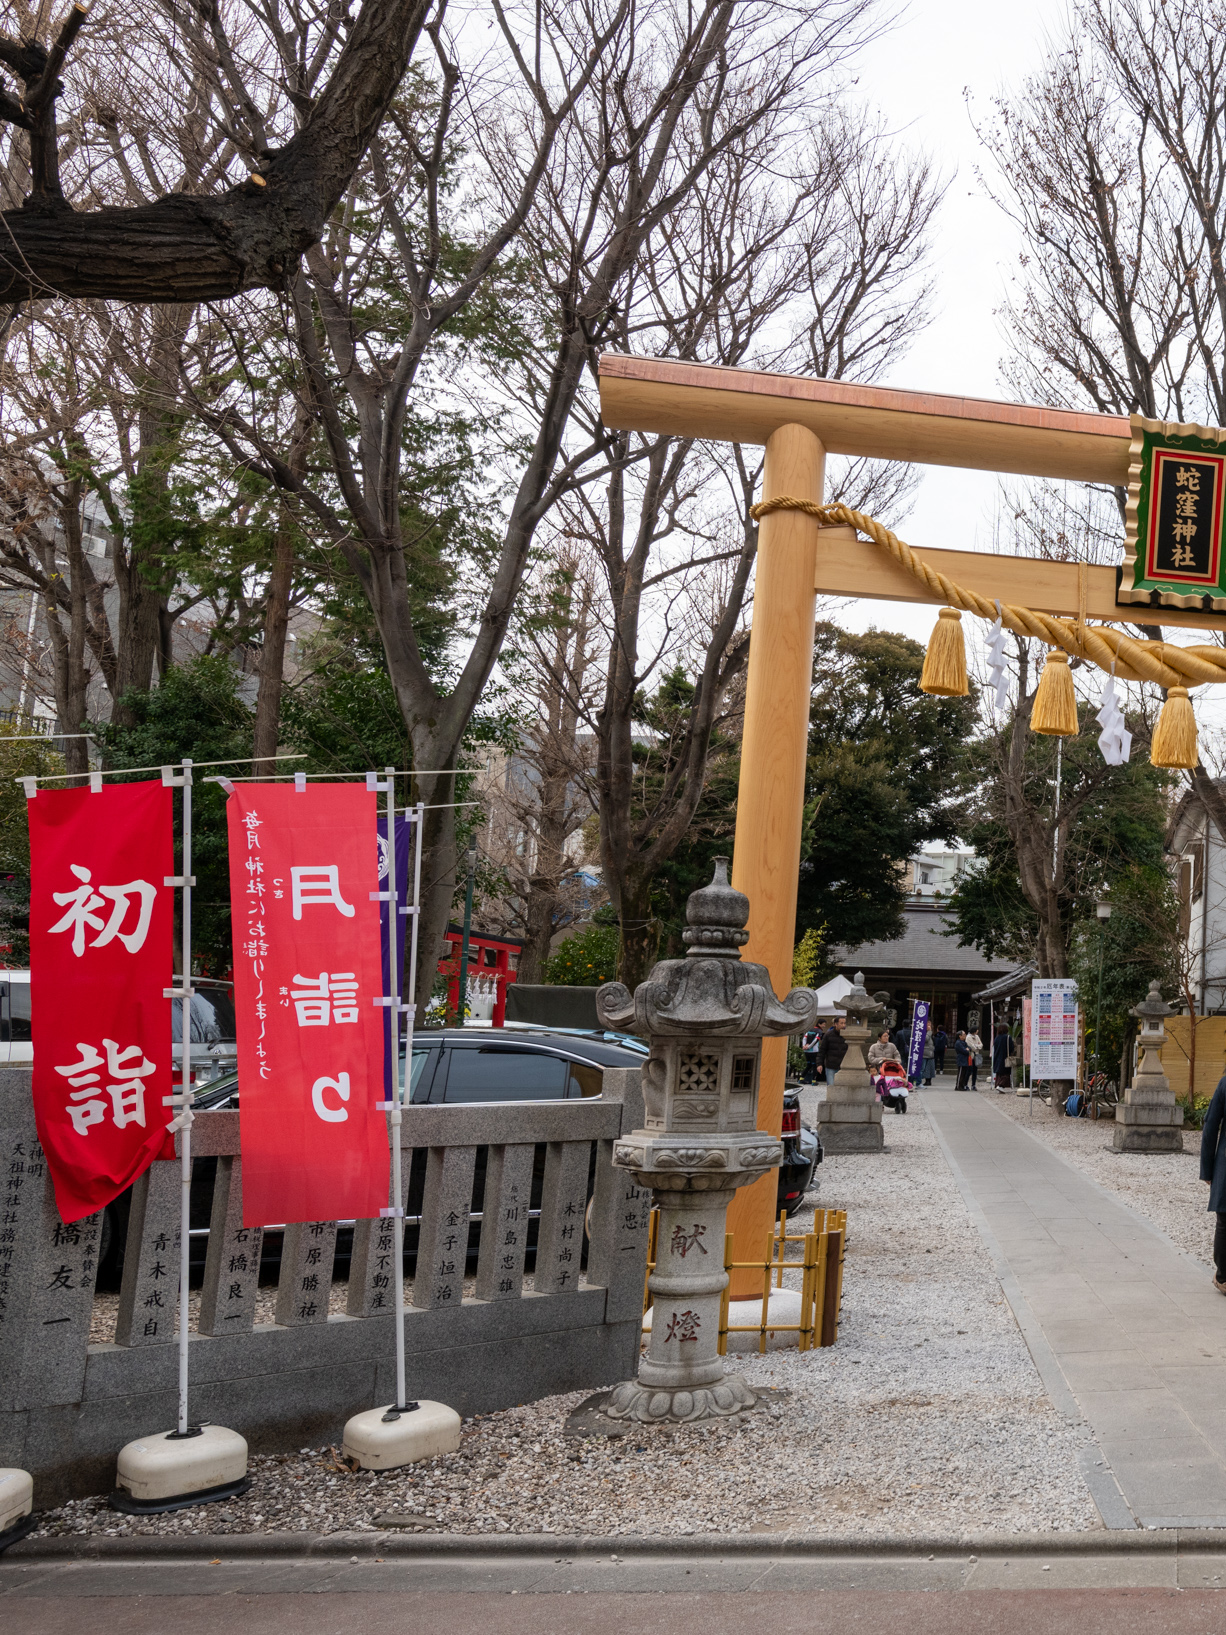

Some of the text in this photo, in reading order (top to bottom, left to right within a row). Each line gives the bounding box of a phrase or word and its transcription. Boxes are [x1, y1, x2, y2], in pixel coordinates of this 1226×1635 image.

[1170, 466, 1201, 568] 蛇窪神社
[47, 863, 157, 1136] 初詣
[224, 1228, 249, 1320] 石橋良一
[371, 1217, 395, 1309] 荏原不動産
[437, 1211, 460, 1301] 金子恒治
[500, 1207, 518, 1293] 川島忠雄
[557, 1202, 578, 1287] 木村尚子
[665, 1223, 708, 1343] 献燈
